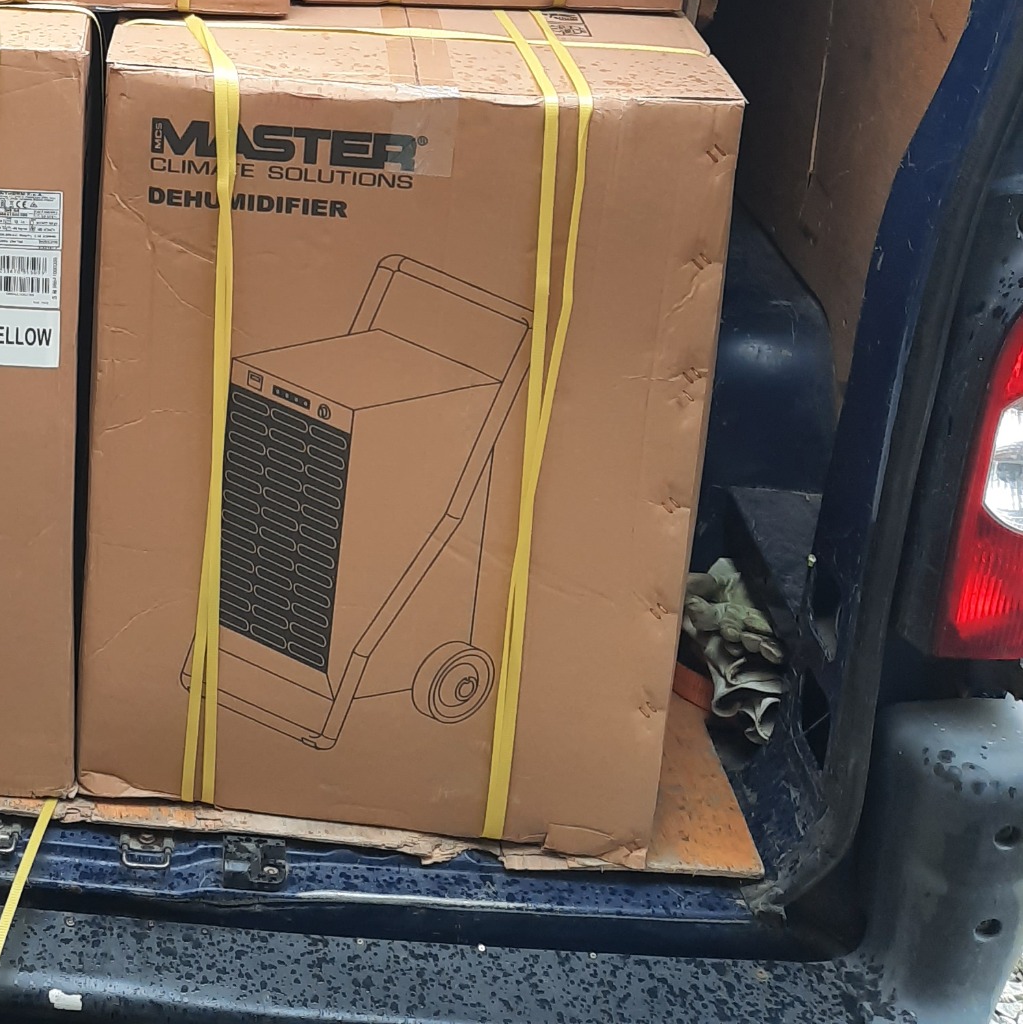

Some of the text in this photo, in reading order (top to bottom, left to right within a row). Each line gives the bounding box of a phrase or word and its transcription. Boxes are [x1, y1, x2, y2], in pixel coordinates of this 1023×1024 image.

[154, 122, 163, 149] MCS
[161, 118, 417, 172] MASTER
[150, 157, 413, 189] CLIME SOLUTIONS
[148, 186, 348, 218] DEHUMIDIFIER
